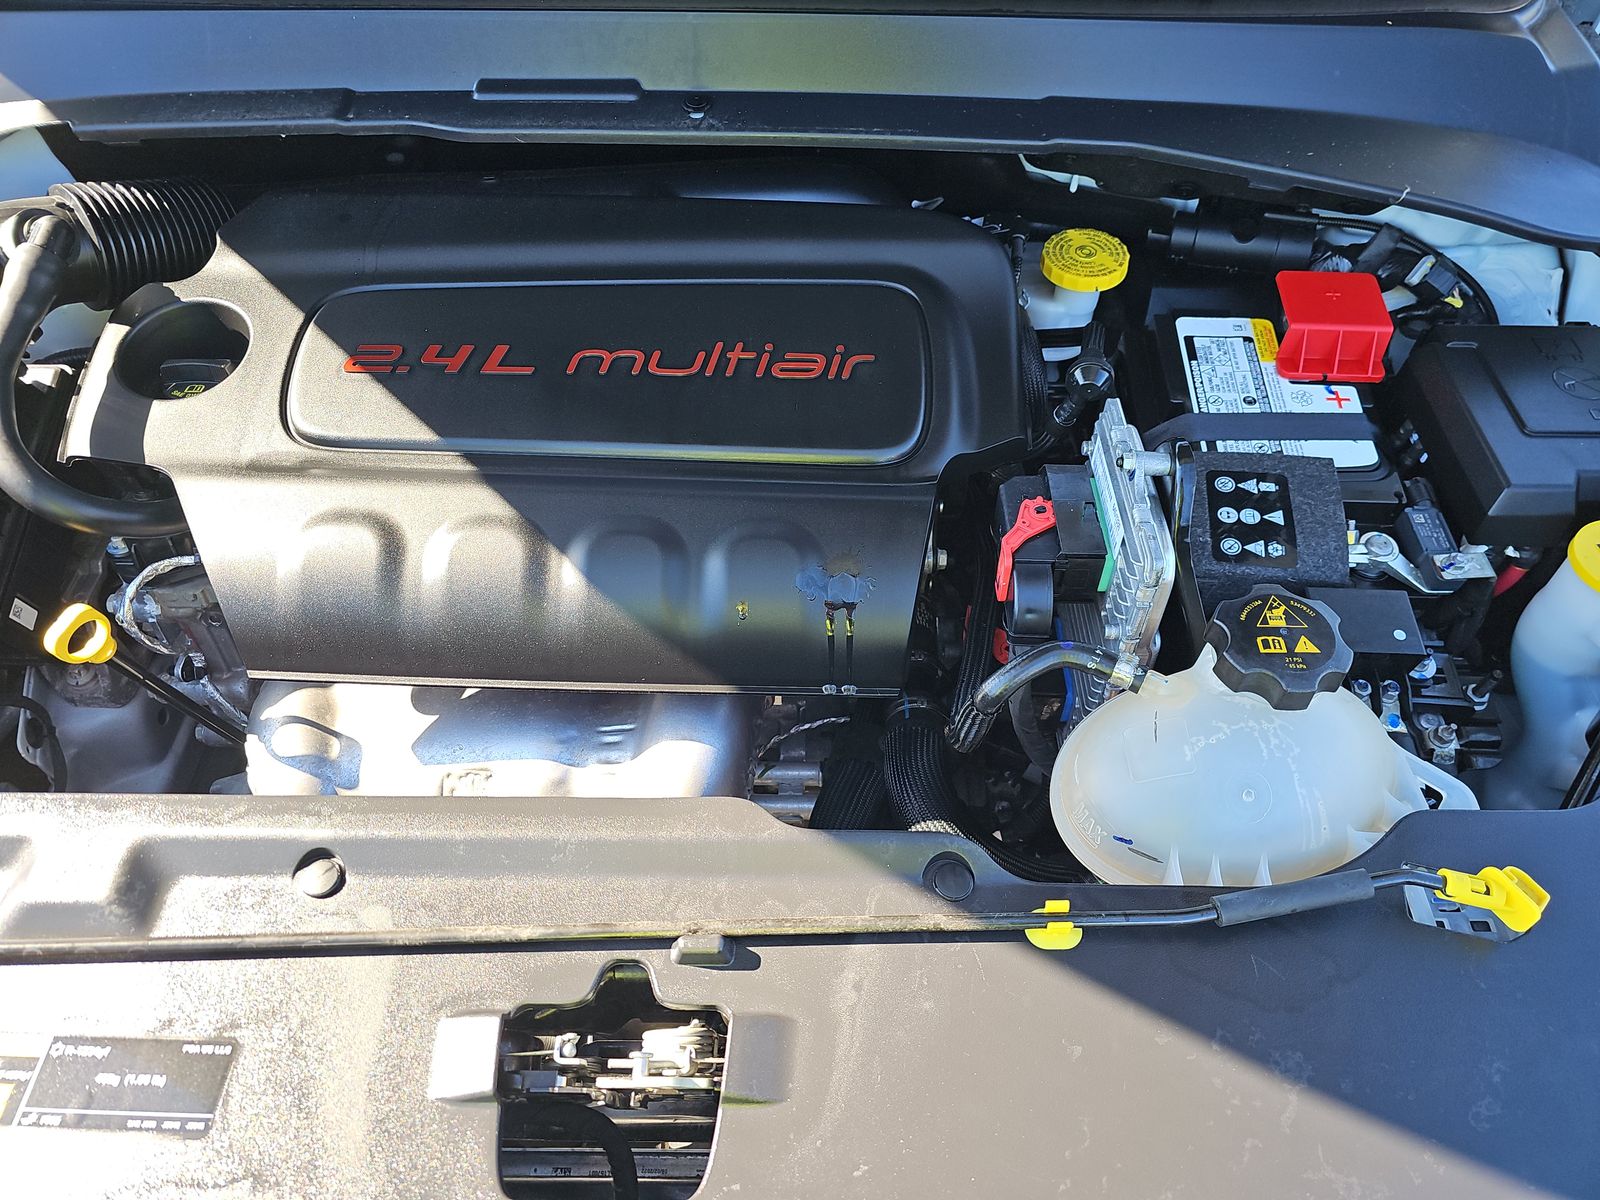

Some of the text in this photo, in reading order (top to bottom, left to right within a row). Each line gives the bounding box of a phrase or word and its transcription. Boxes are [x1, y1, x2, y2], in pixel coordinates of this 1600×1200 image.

[343, 341, 876, 381] 2.4L multiair
[1190, 360, 1208, 413] ANGER/POISON
[1072, 801, 1107, 846] MAX
